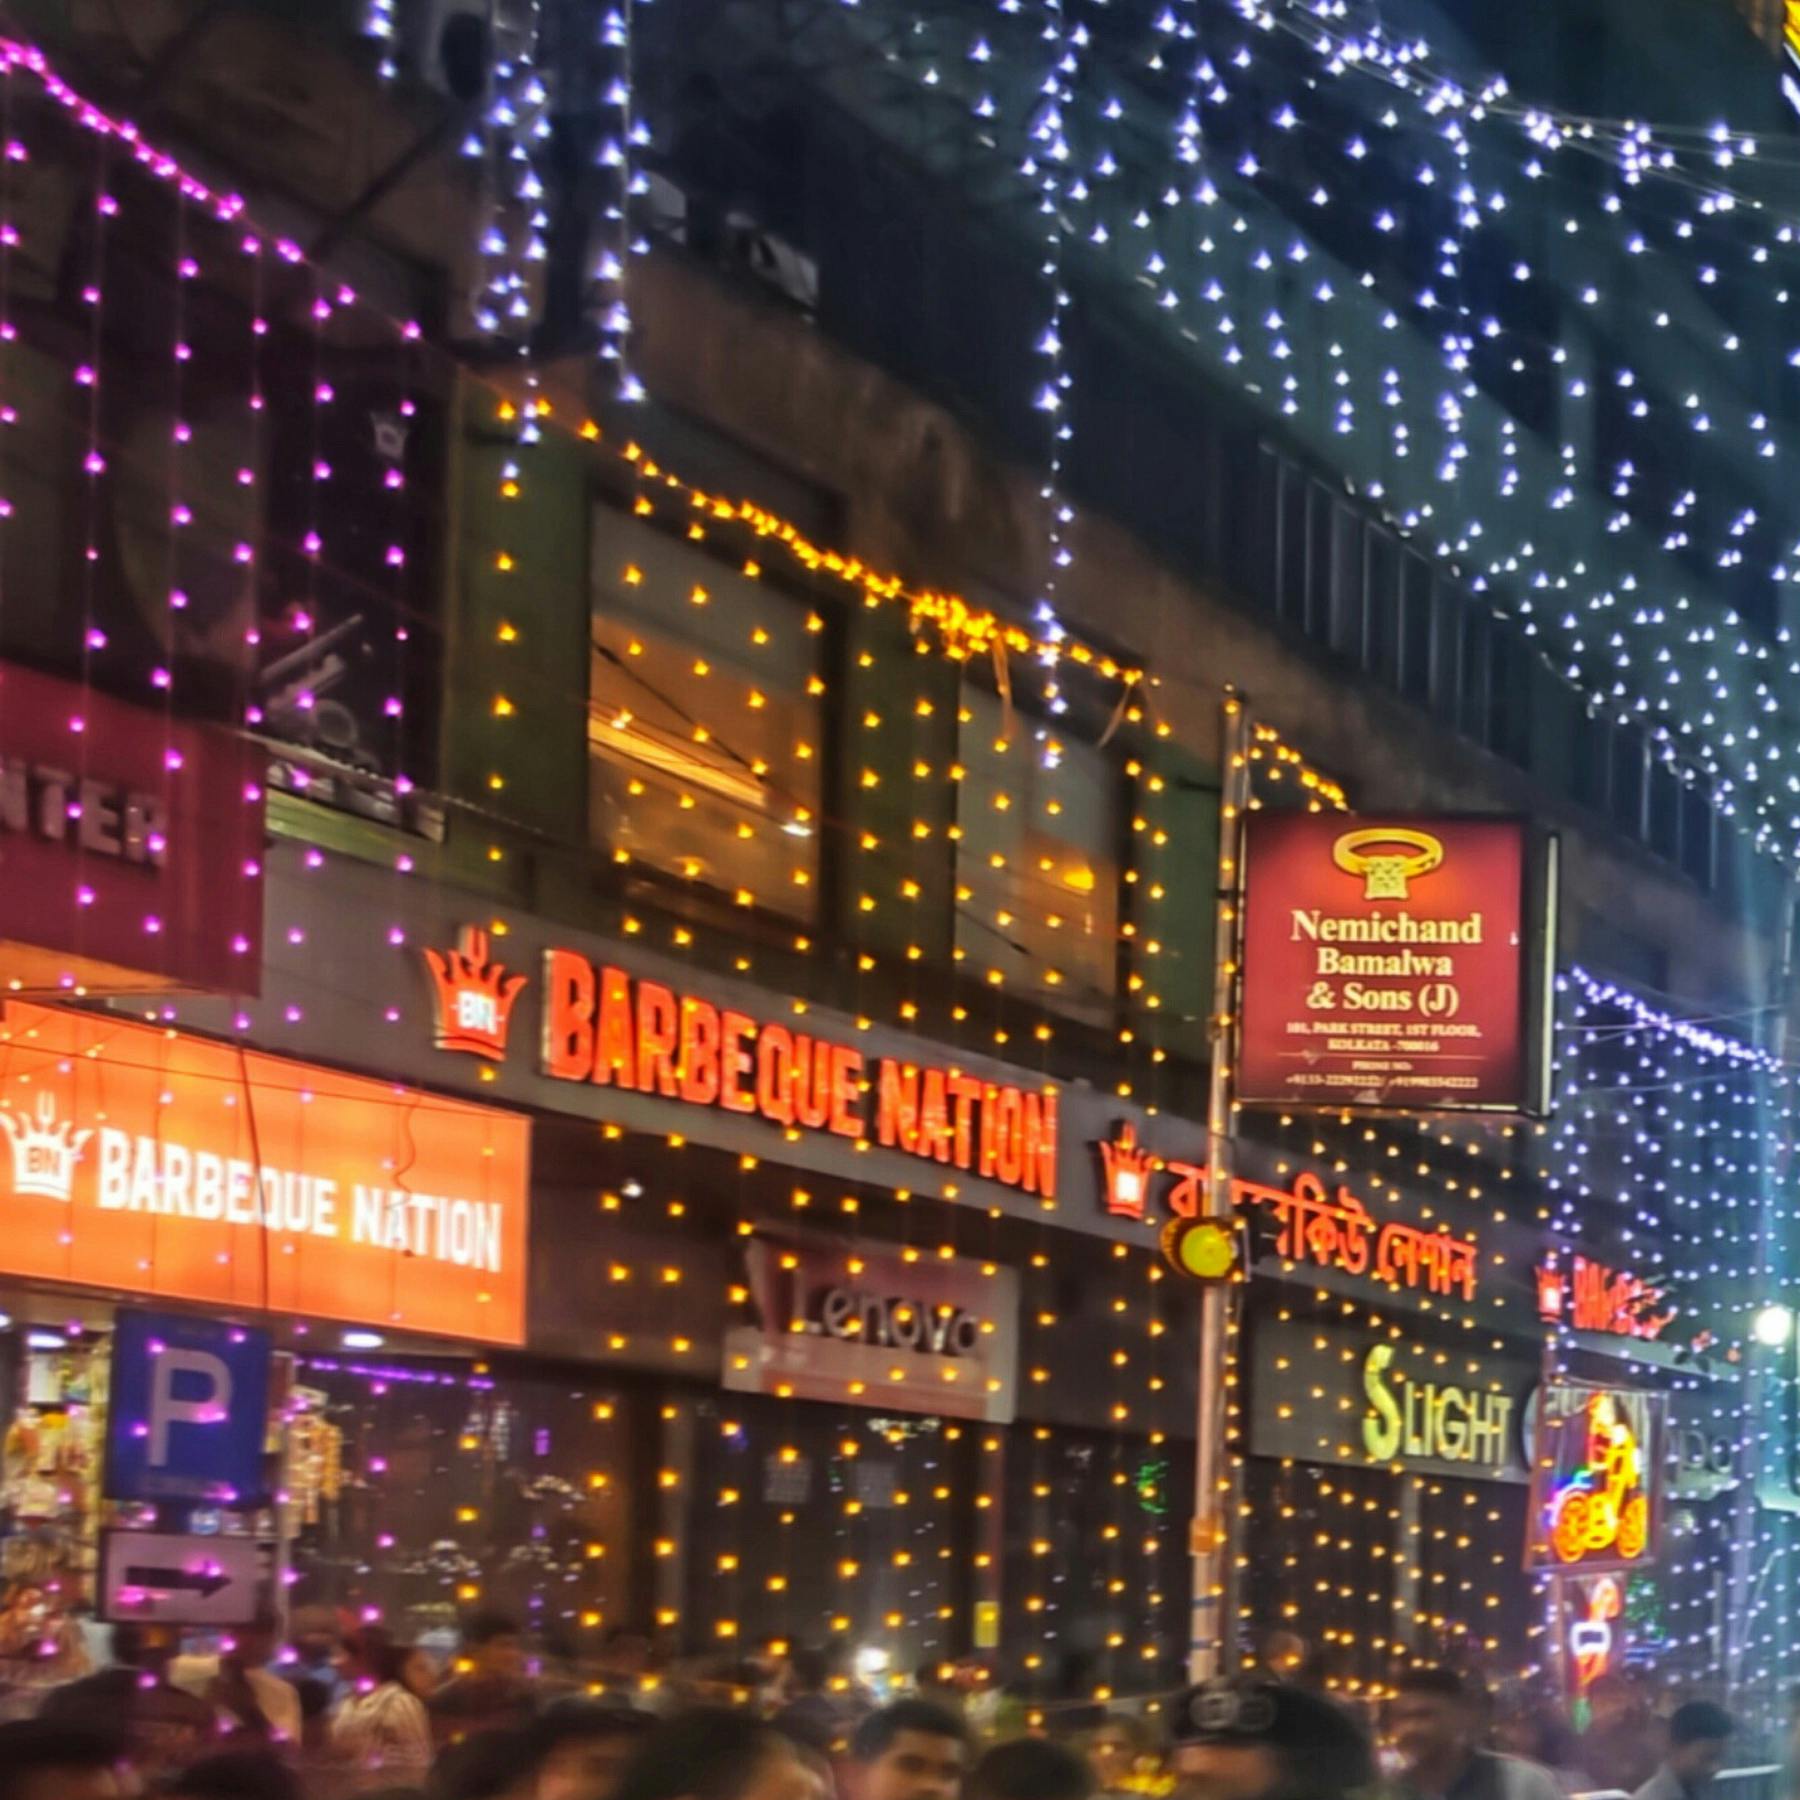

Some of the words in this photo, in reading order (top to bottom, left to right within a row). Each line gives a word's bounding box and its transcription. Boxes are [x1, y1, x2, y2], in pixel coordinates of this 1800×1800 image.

[1290, 909, 1482, 944] Nemichand
[1317, 947, 1453, 976] Bamalwa
[1306, 981, 1336, 1009] &
[1343, 982, 1412, 1011] Sons
[1418, 984, 1459, 1017] (J)
[543, 947, 865, 1138] BARBEQUE
[878, 1058, 1059, 1198] NATION
[98, 1126, 339, 1237] BARBEQUE
[352, 1183, 502, 1272] NATION
[148, 1347, 232, 1468] P
